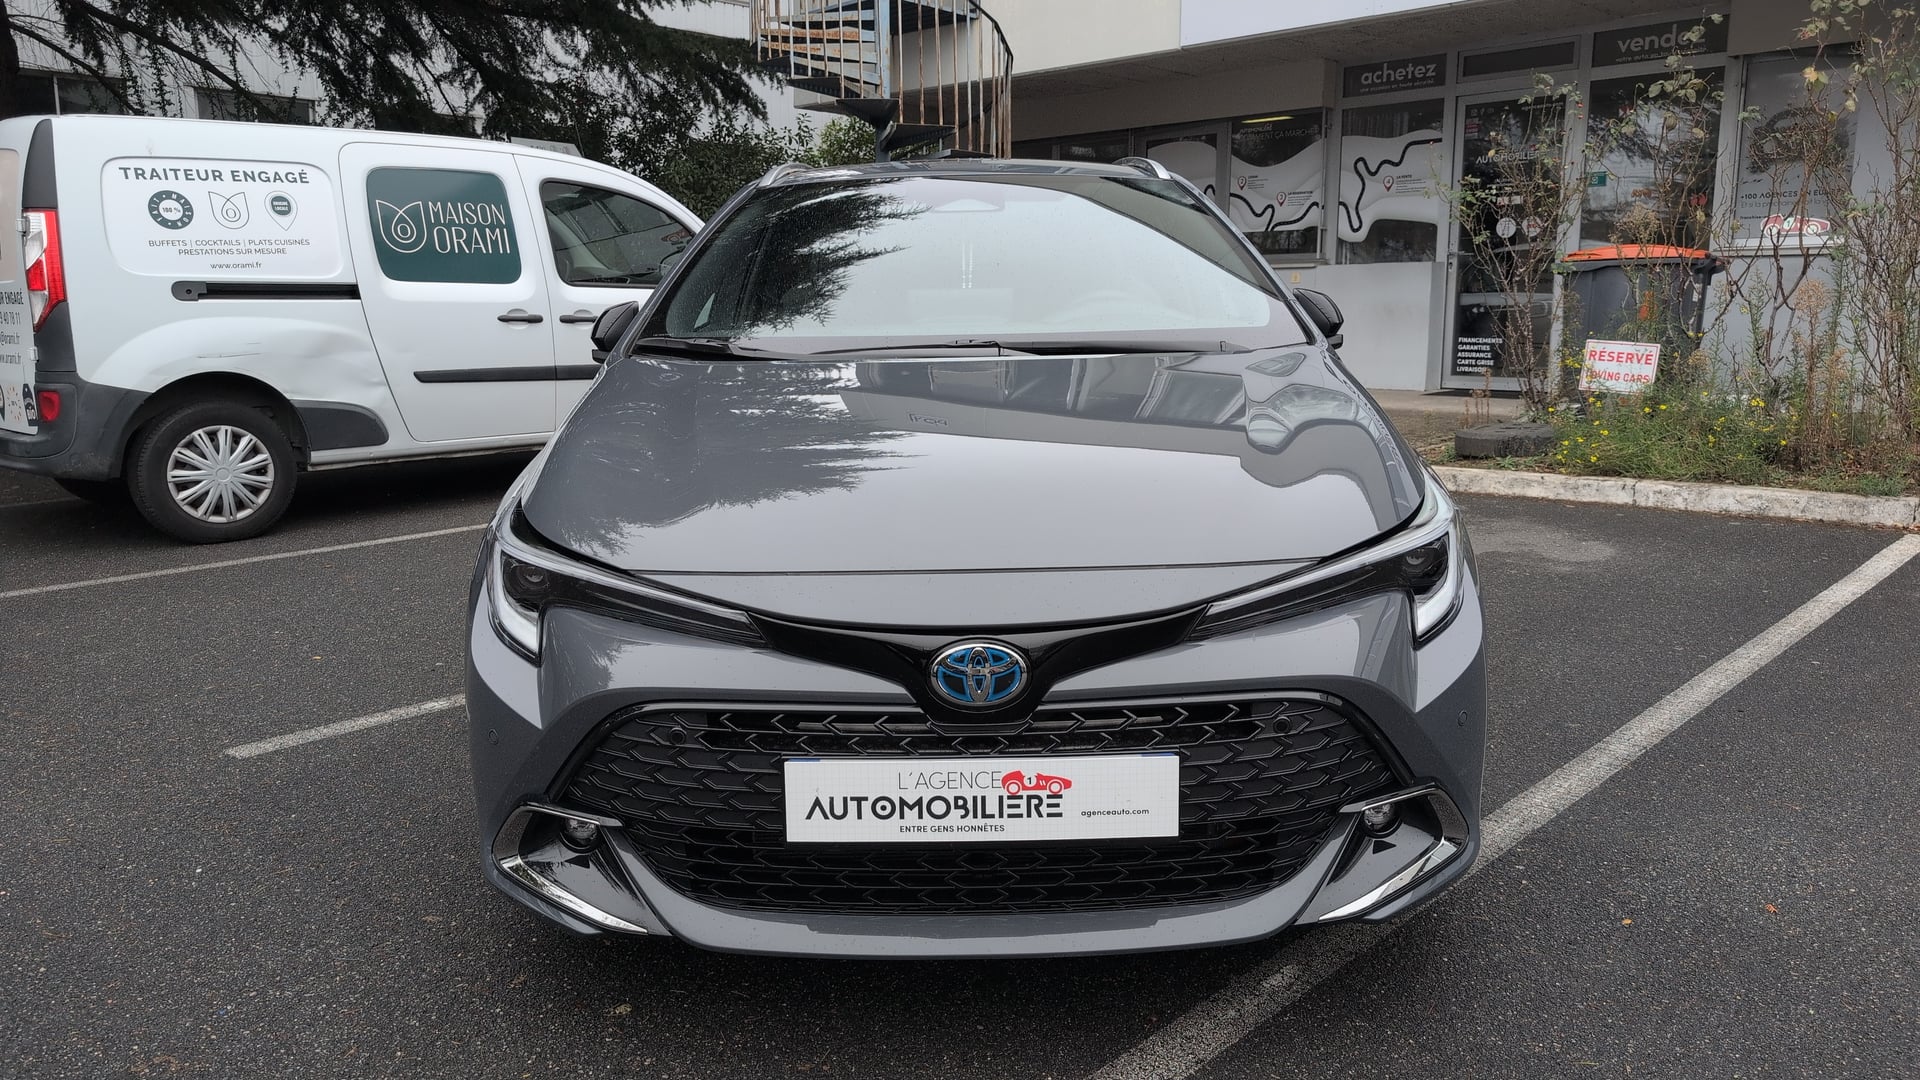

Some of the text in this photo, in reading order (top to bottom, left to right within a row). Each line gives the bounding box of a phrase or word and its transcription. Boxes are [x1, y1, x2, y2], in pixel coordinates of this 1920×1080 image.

[1361, 63, 1437, 85] achetez
[118, 166, 310, 184] TRAITEUR ENGAGÉ
[428, 201, 506, 226] MAISON
[148, 239, 188, 247] BUFFETS
[195, 239, 241, 247] COCKTAILS
[274, 238, 310, 246] CUISINÉS
[433, 226, 511, 254] ORAMI
[178, 248, 235, 256] PRESTATIONS
[254, 247, 288, 255] MESURE
[210, 261, 262, 269] www.orami.fr
[5, 288, 23, 305] ENGAGÉ
[0, 331, 20, 346] @orami.fr
[1588, 346, 1654, 365] RÉSERVÉ
[1587, 369, 1650, 383] OVING CARS
[898, 770, 1002, 790] L'AGENCE
[1080, 806, 1150, 818] agenceauto.com
[899, 822, 1005, 833] ENTRE GENS HONNÊTES
